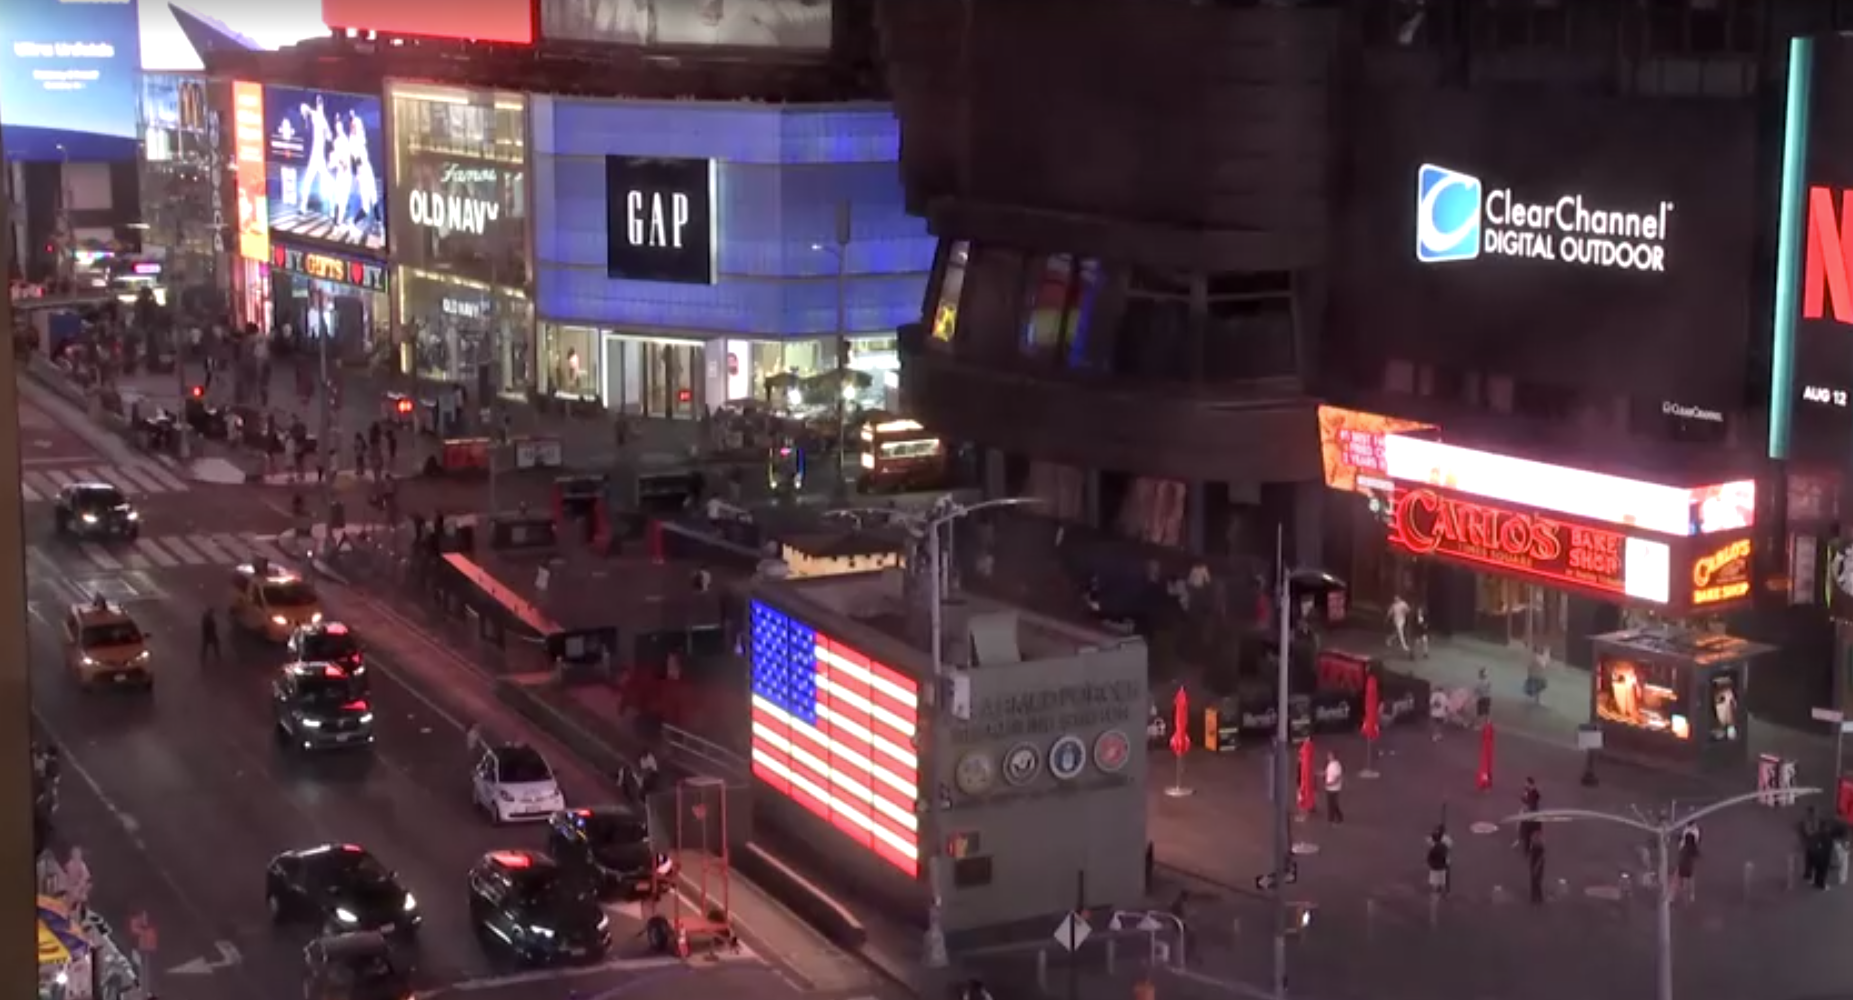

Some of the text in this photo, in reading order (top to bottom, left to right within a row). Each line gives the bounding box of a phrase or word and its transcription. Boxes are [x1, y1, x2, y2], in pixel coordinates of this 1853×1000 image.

[409, 189, 499, 235] OLD NAVY
[626, 190, 688, 249] GAP
[1485, 187, 1667, 240] ClearChannel
[305, 252, 344, 282] GIFTS
[1484, 229, 1664, 272] DIGITAL OUTDOOR
[1802, 386, 1847, 407] AUG 12
[1396, 489, 1561, 560] CARLO'S
[1571, 526, 1618, 555] BAKE
[1569, 547, 1619, 575] SHOP
